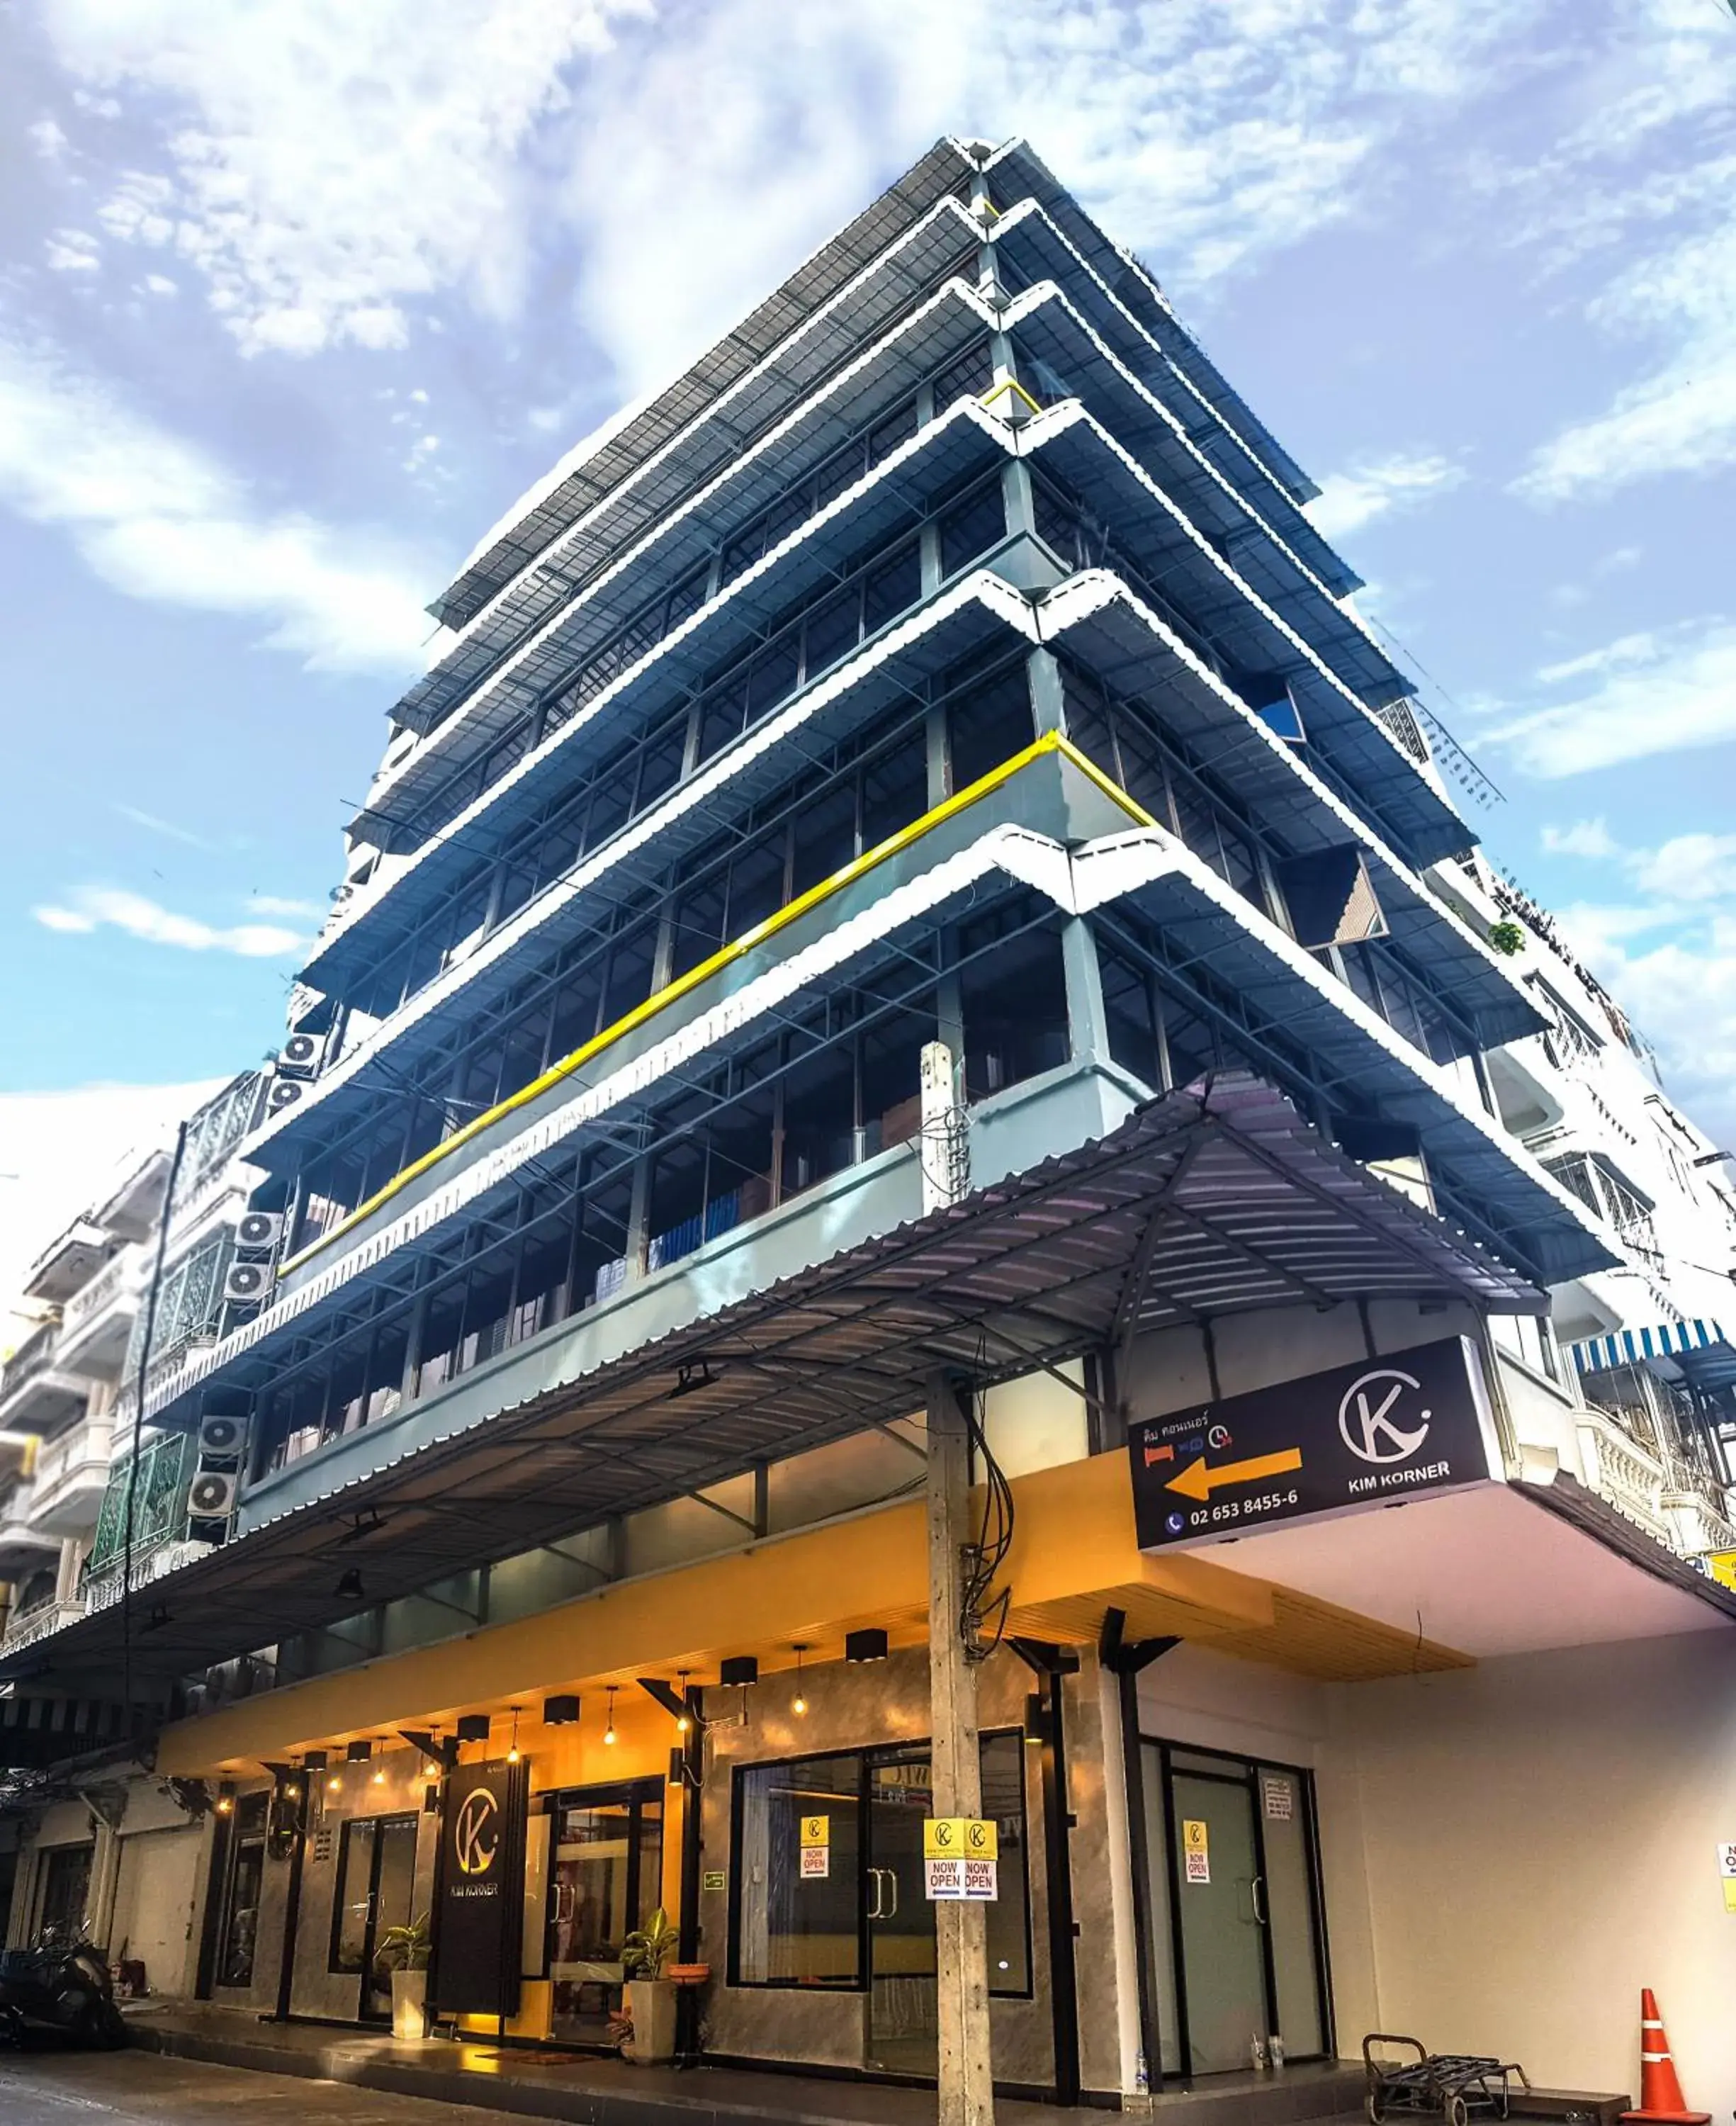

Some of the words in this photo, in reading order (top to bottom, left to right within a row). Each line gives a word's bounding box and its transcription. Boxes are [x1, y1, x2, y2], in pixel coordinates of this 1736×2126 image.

[1348, 1475, 1377, 1494] KIM
[1380, 1460, 1450, 1486] KORNER
[1190, 1509, 1209, 1526] 02
[1212, 1502, 1240, 1521] 653
[1244, 1489, 1298, 1514] 8455-6
[933, 1862, 957, 1873] NOW
[966, 1862, 989, 1874] NOW
[930, 1875, 960, 1886] OPEN
[965, 1874, 992, 1887] OPEN
